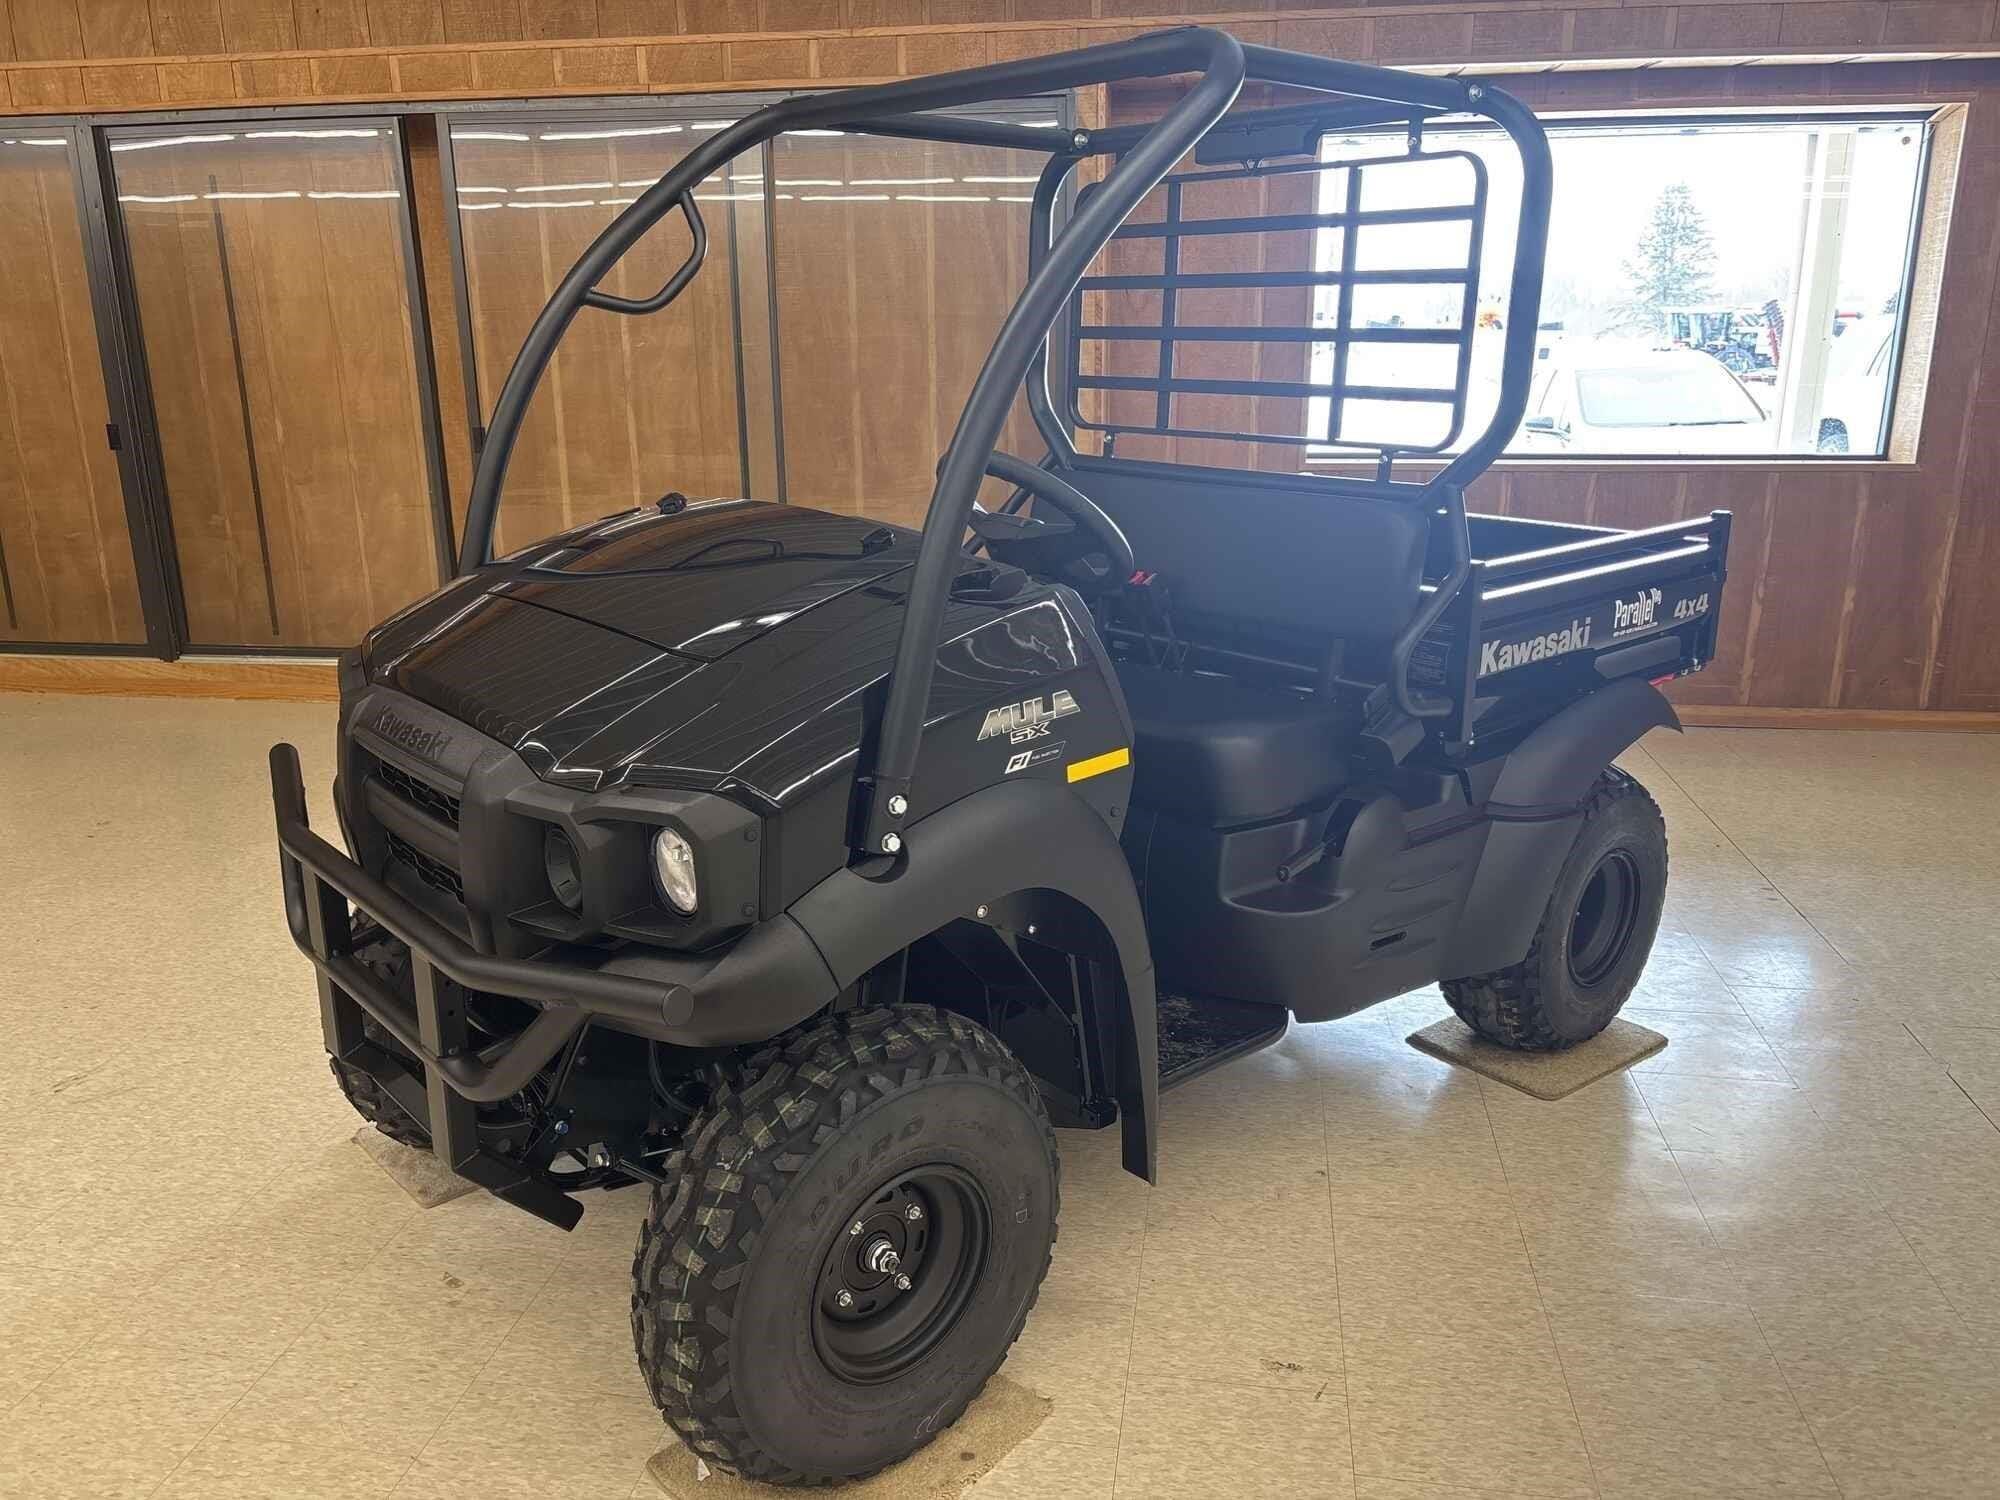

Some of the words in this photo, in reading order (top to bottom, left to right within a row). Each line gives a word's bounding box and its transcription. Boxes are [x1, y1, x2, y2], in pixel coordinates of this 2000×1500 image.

[1673, 593, 1710, 620] 4x4
[1479, 616, 1592, 676] Kawasaki
[370, 703, 453, 760] Kawasaki
[976, 689, 1081, 742] MULE
[1010, 721, 1051, 744] SX
